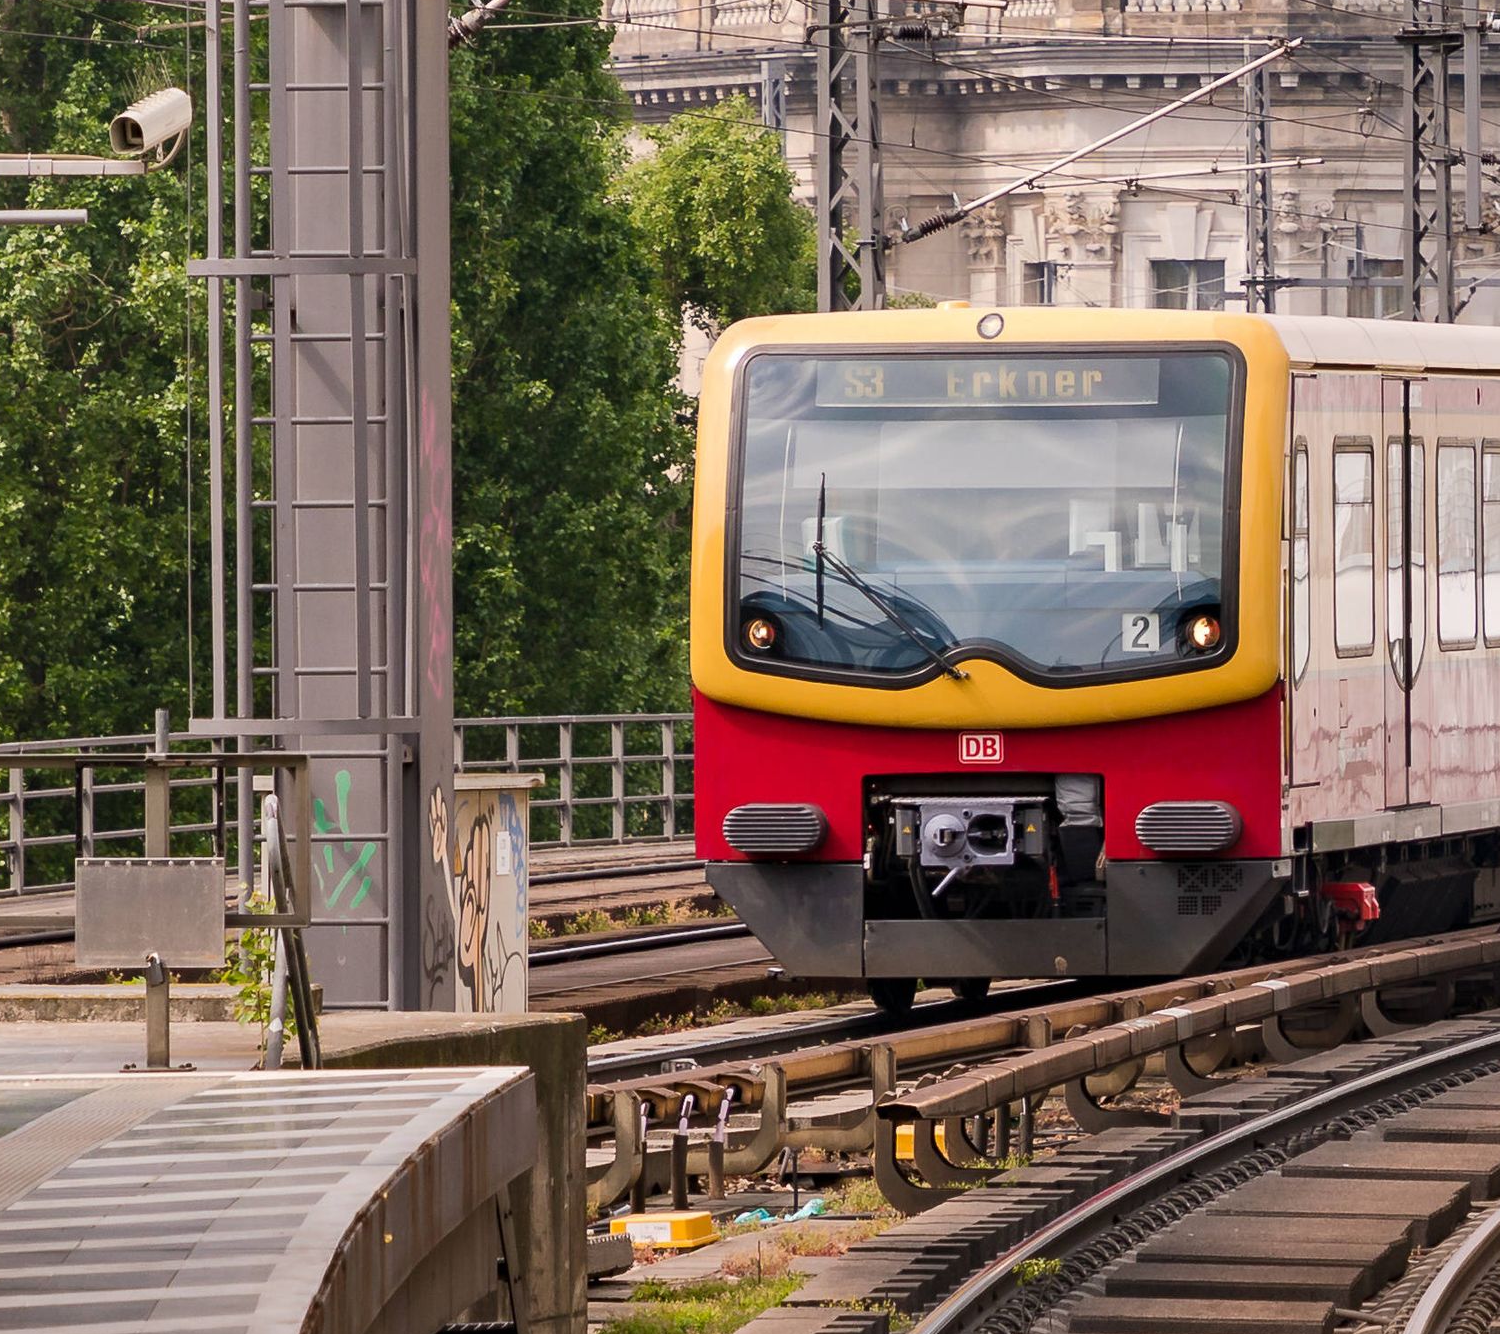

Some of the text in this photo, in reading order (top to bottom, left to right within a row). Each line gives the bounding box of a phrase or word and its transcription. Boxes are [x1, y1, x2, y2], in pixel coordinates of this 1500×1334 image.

[844, 364, 1103, 398] S3 Erkner
[1131, 618, 1151, 649] 2
[964, 736, 998, 758] DB
